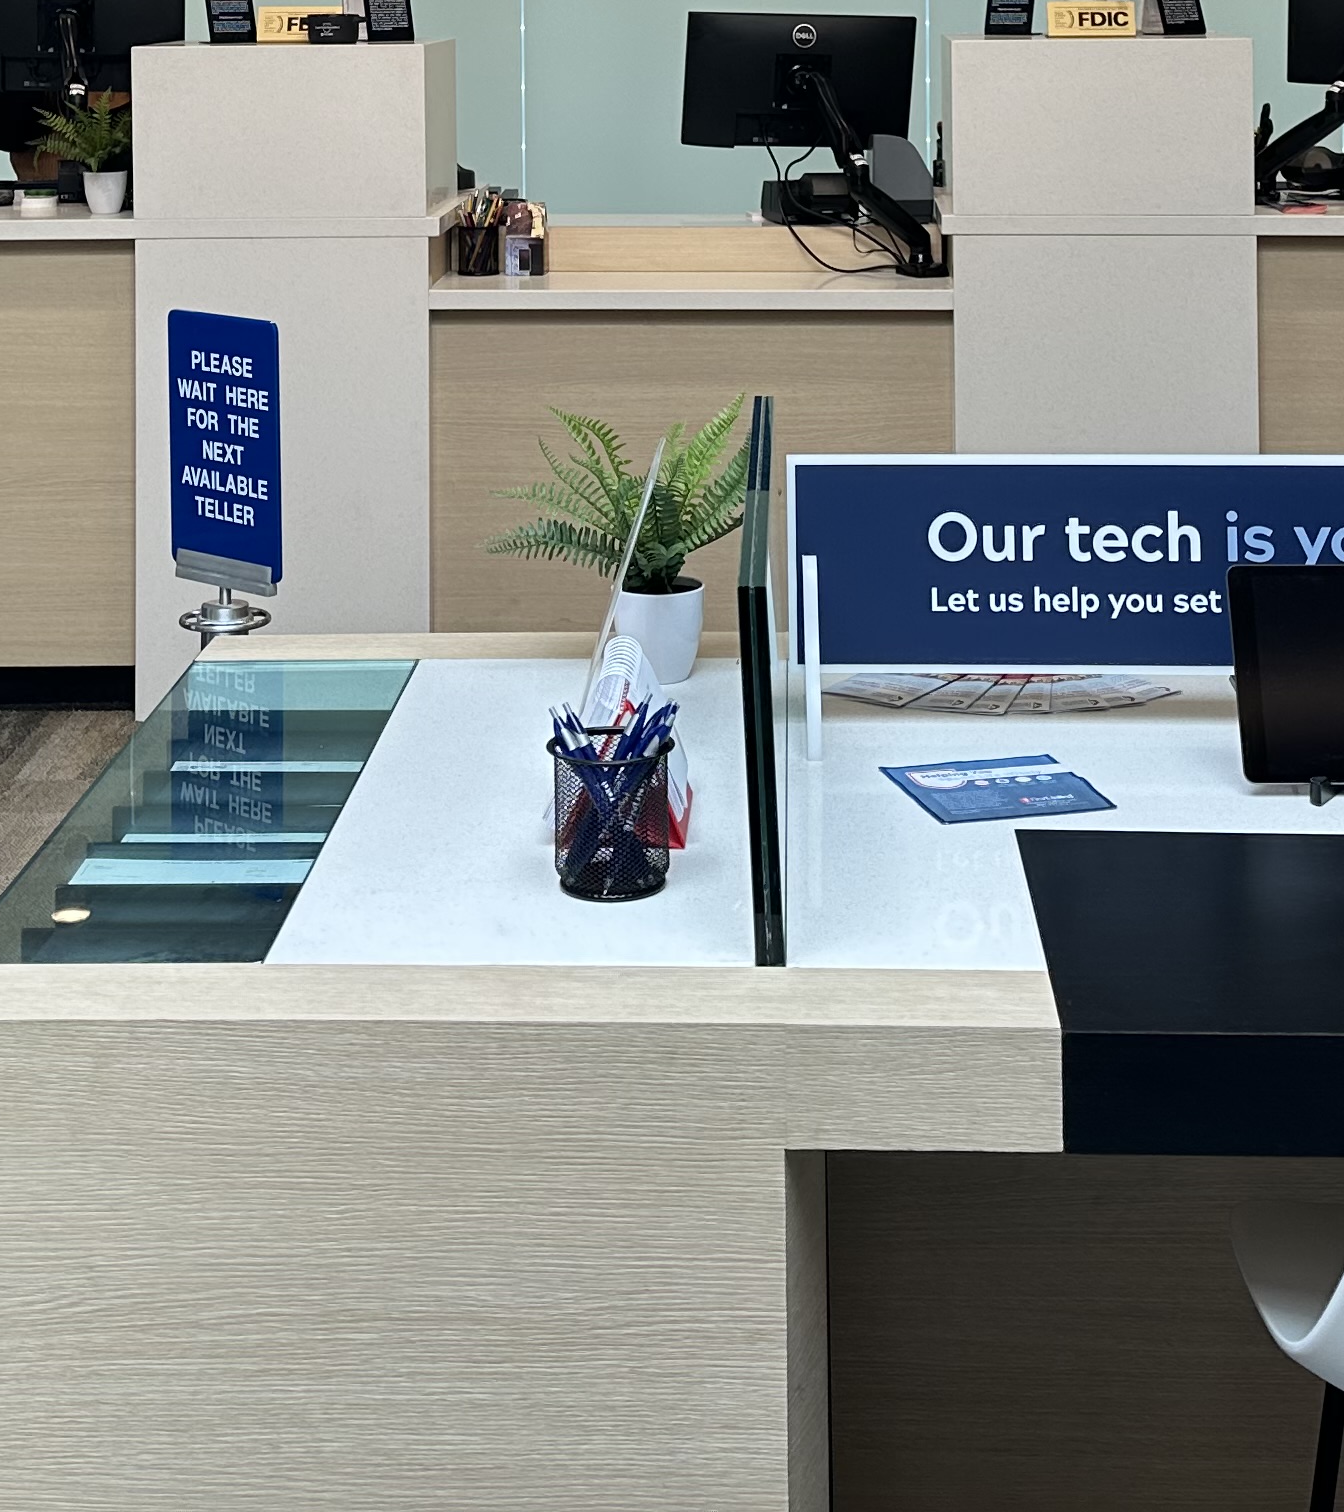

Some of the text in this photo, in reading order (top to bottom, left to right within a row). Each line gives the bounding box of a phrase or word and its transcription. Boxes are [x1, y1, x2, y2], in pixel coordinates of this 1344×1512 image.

[1078, 11, 1129, 27] FDIC
[191, 350, 253, 379] PLEASE
[177, 378, 269, 412] WAIT HERE
[187, 407, 260, 439] FOR THE
[202, 439, 244, 466] NEXT
[181, 465, 268, 501] AVAILABLE
[194, 496, 255, 527] TELLER
[927, 511, 1046, 563] Our
[1064, 510, 1202, 563] tech
[1225, 510, 1275, 563] is
[931, 585, 1223, 620] Let us help you set
